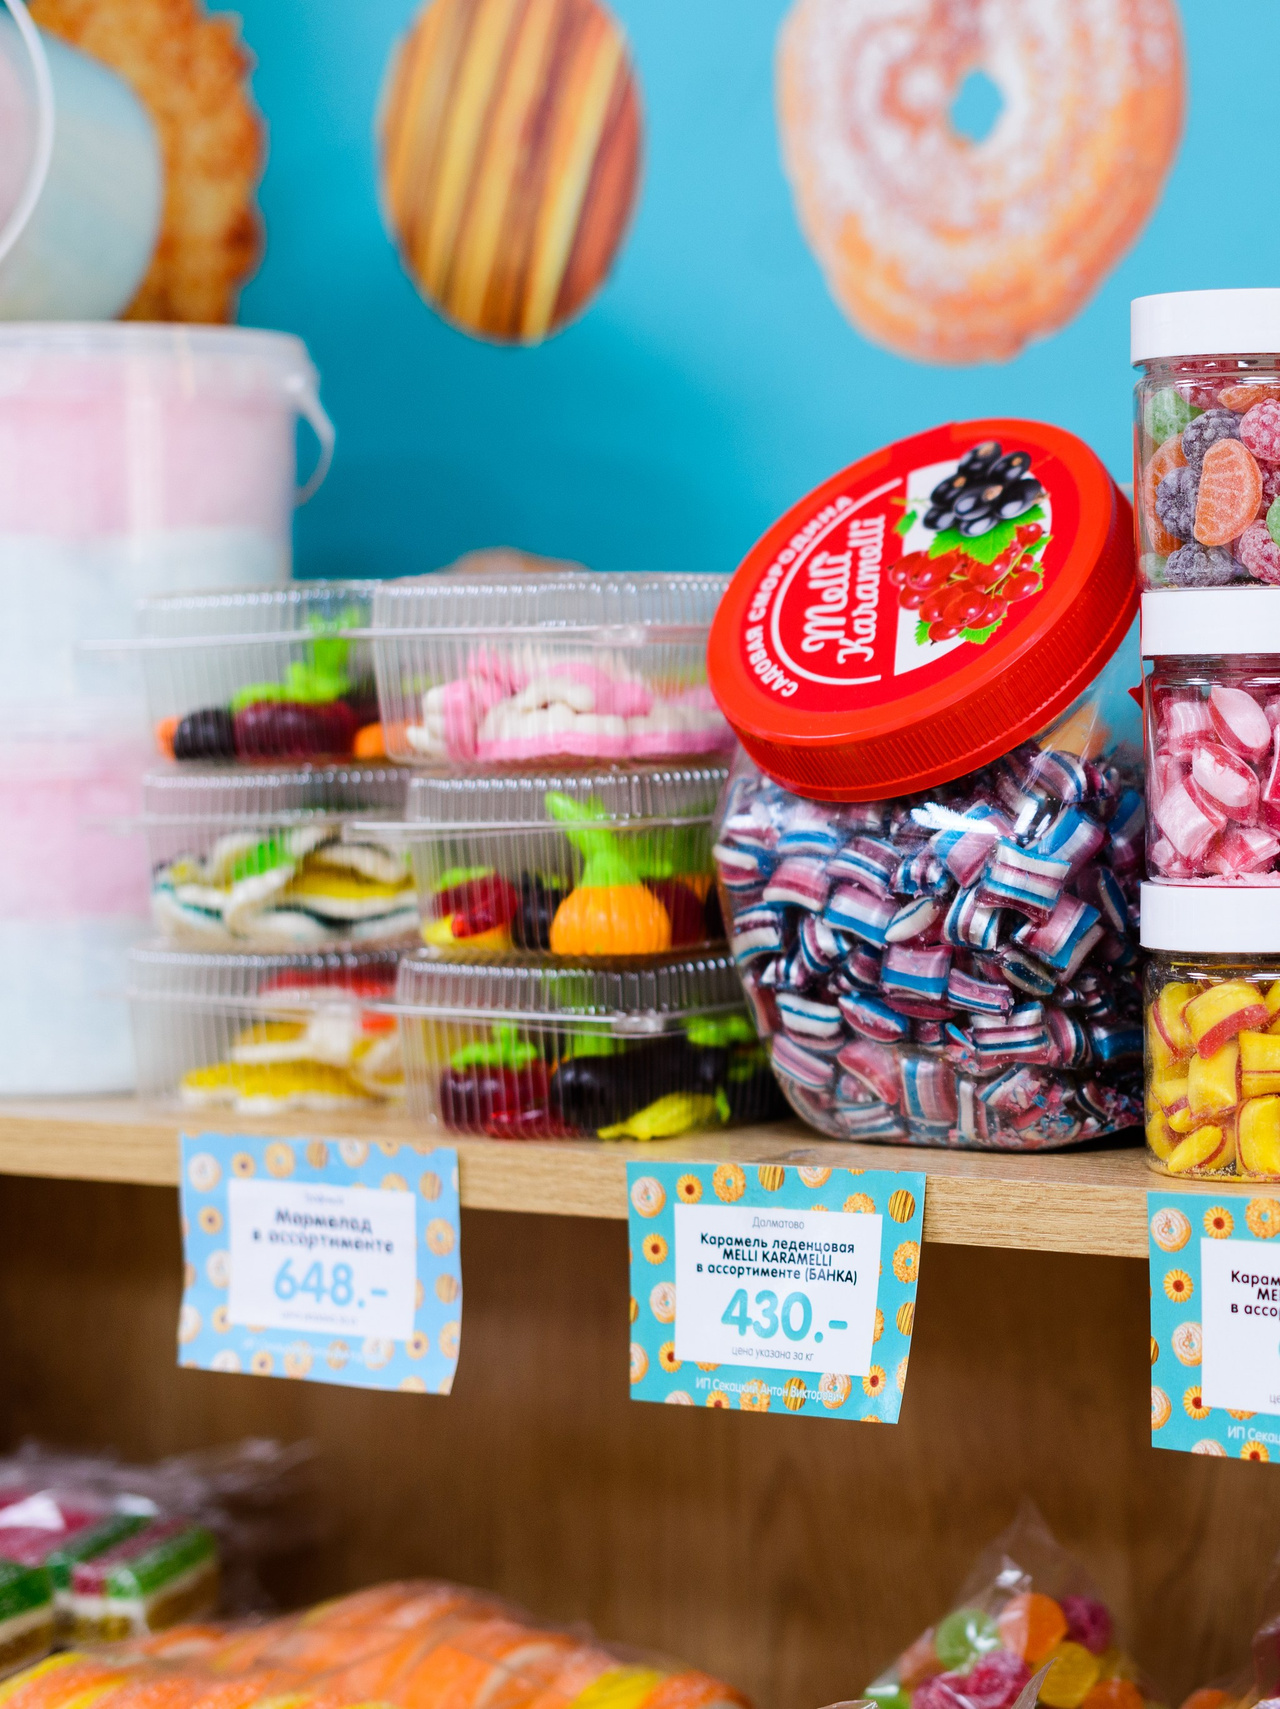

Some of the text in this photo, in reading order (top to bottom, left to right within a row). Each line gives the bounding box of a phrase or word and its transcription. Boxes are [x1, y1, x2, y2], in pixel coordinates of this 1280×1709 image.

[746, 496, 854, 697] САДОВАЯ СМОРОДИНА
[837, 514, 886, 664] Karamelli
[801, 551, 852, 653] Melli
[275, 1208, 373, 1234] Мармелад
[268, 1231, 394, 1254] ассортименте
[700, 1232, 855, 1254] Карамель леденцовая
[723, 1248, 832, 1267] MELLI KARAMELLI
[696, 1263, 857, 1285] в ассортименте (БАНКА)
[721, 1288, 848, 1343] 430.-
[1230, 1303, 1239, 1313] в
[732, 1347, 815, 1361] цена указана за кг
[695, 1377, 711, 1390] ИП
[760, 1383, 789, 1397] Антон
[1227, 1425, 1246, 1440] ИП
